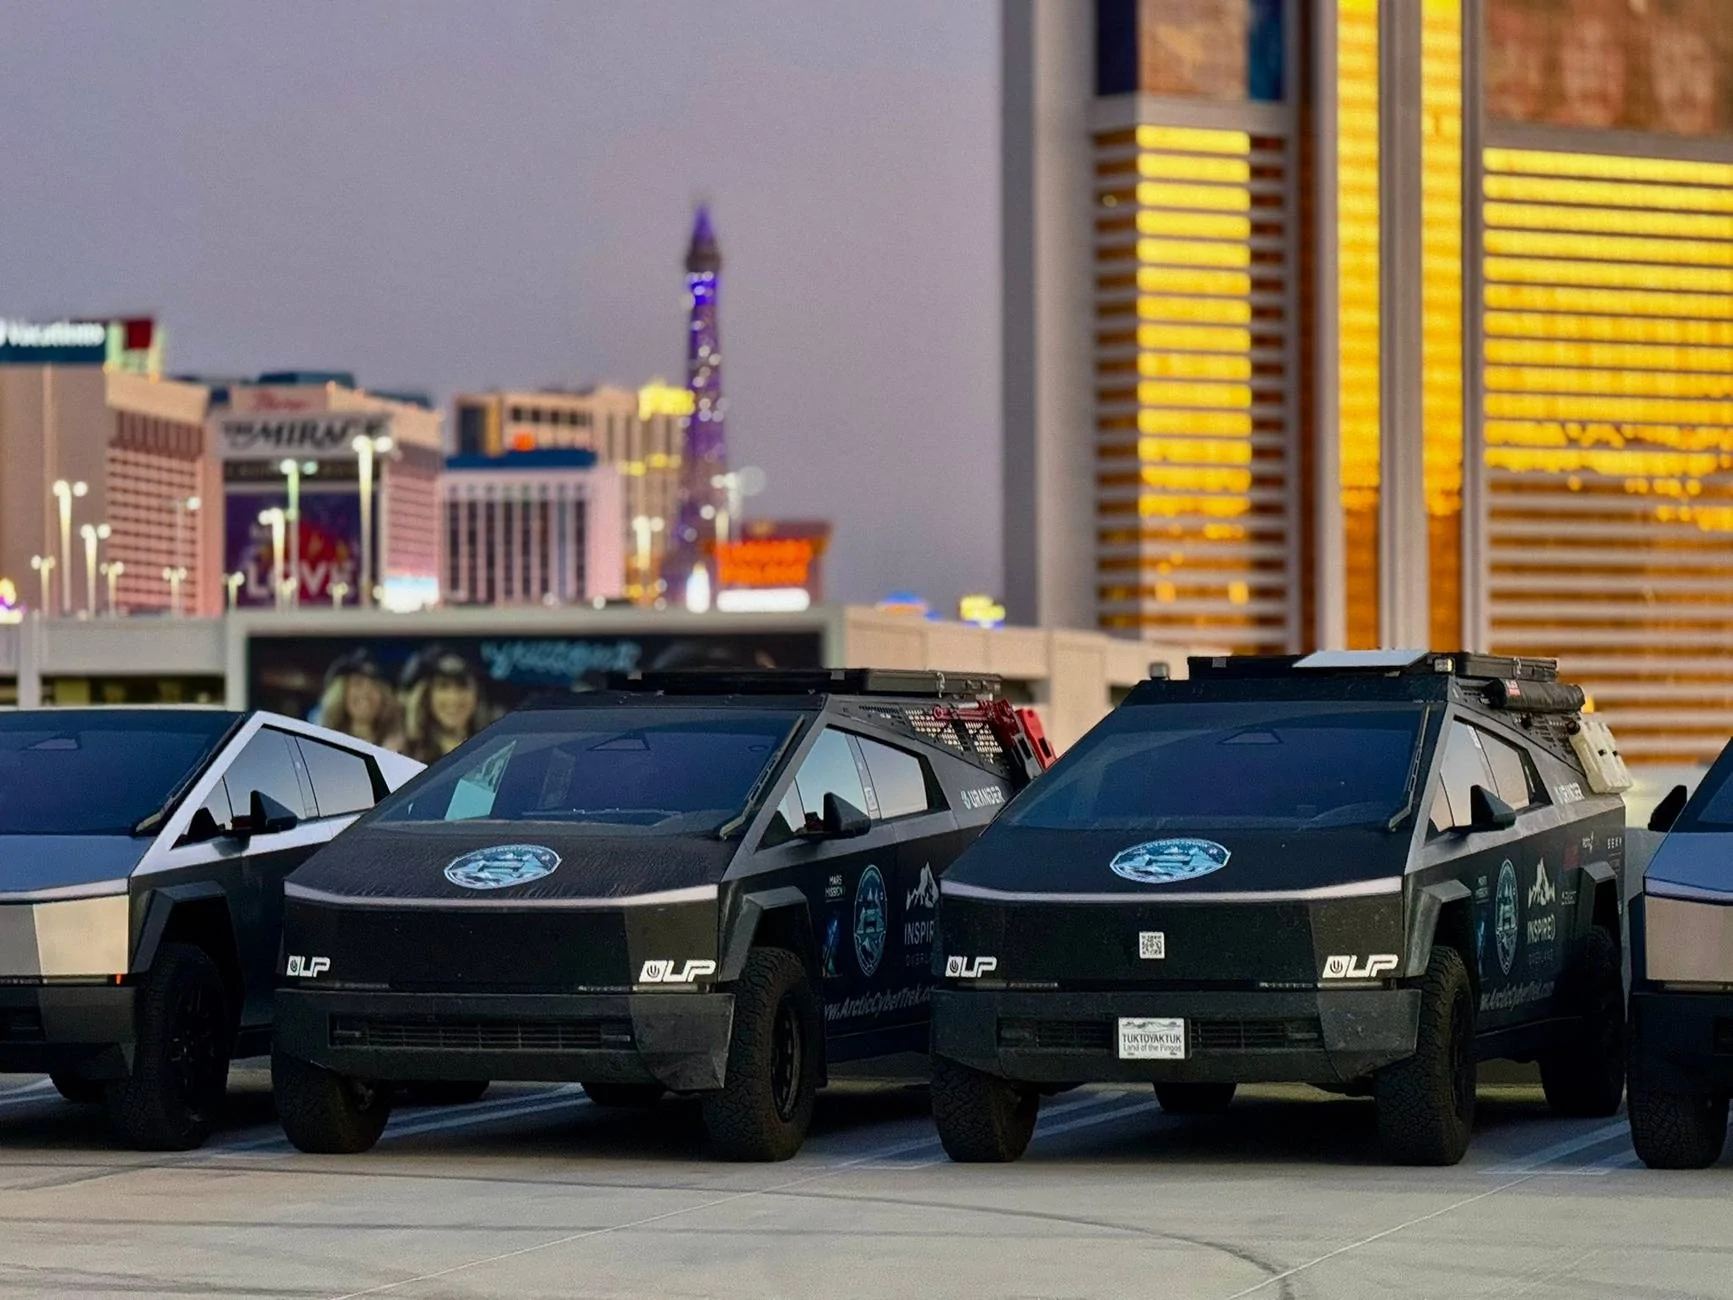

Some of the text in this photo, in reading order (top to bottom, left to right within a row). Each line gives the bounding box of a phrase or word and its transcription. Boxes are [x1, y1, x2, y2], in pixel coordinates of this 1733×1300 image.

[1123, 1033, 1181, 1043] TUKTOYAKTUK
[1123, 1044, 1139, 1052] Land
[1140, 1044, 1148, 1052] of
[1148, 1044, 1159, 1052] the
